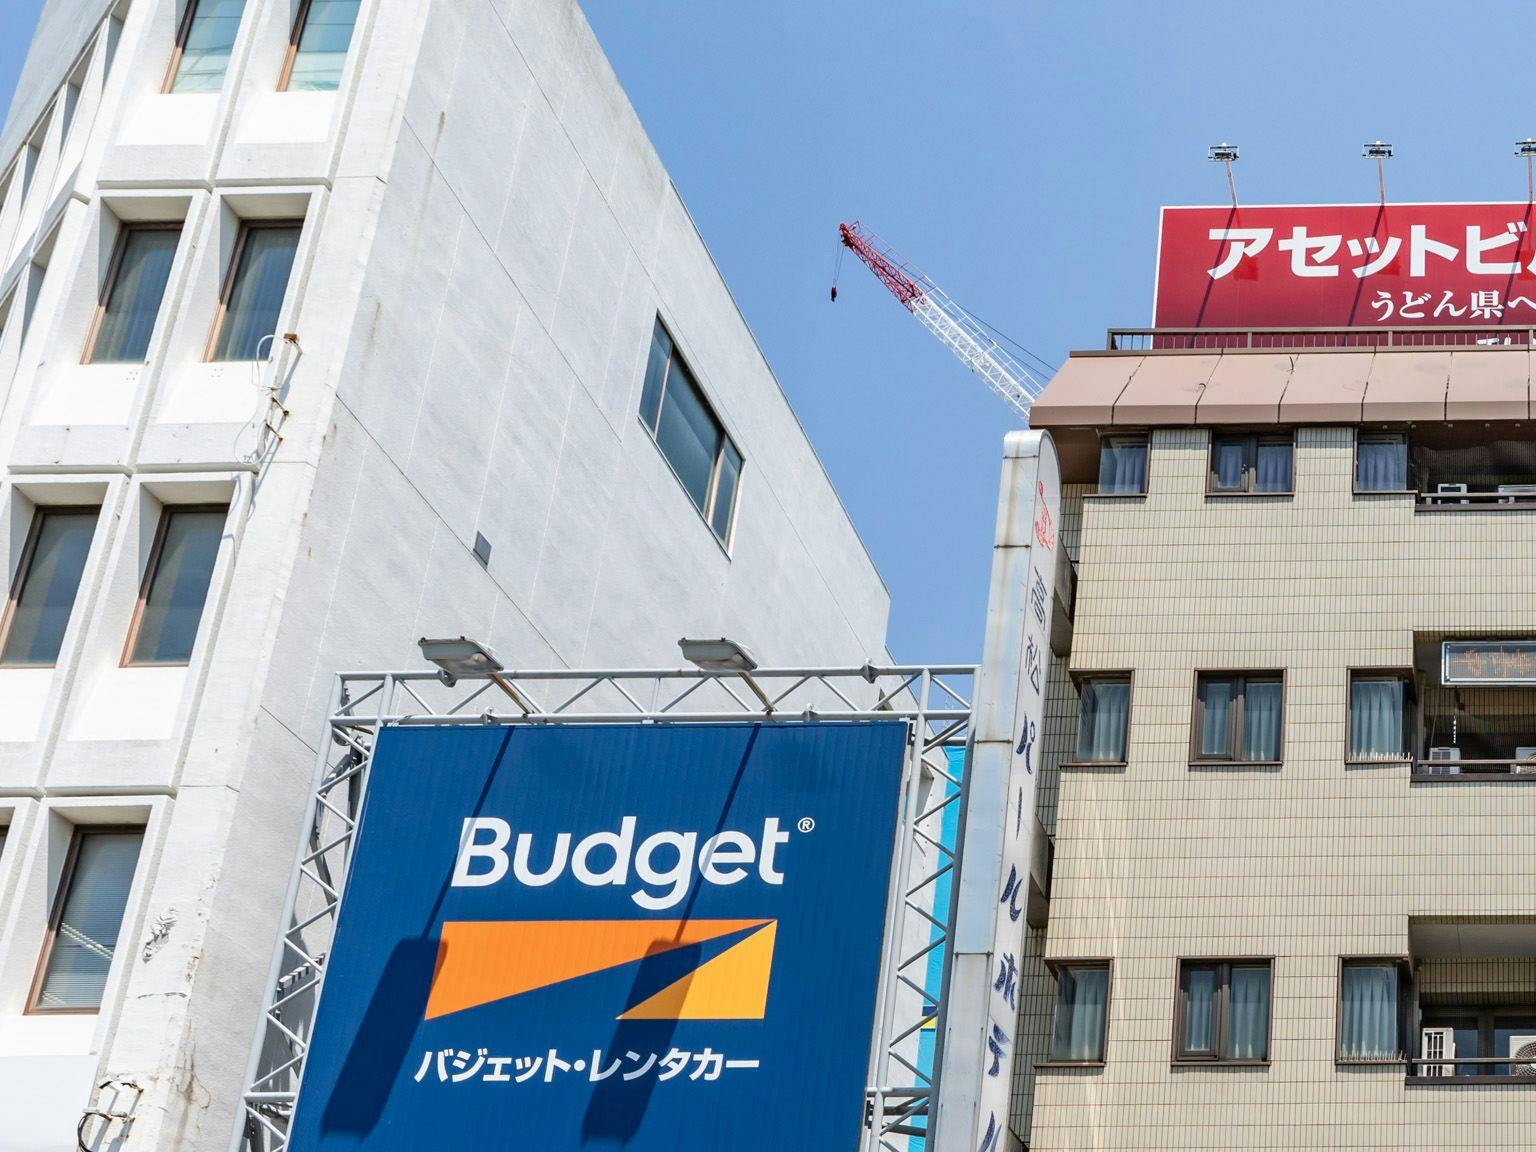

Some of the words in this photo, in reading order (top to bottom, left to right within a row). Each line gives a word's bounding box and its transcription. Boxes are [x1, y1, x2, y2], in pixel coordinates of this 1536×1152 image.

[451, 816, 789, 910] Budget
[414, 1048, 760, 1083] バジェット・レンタカー
